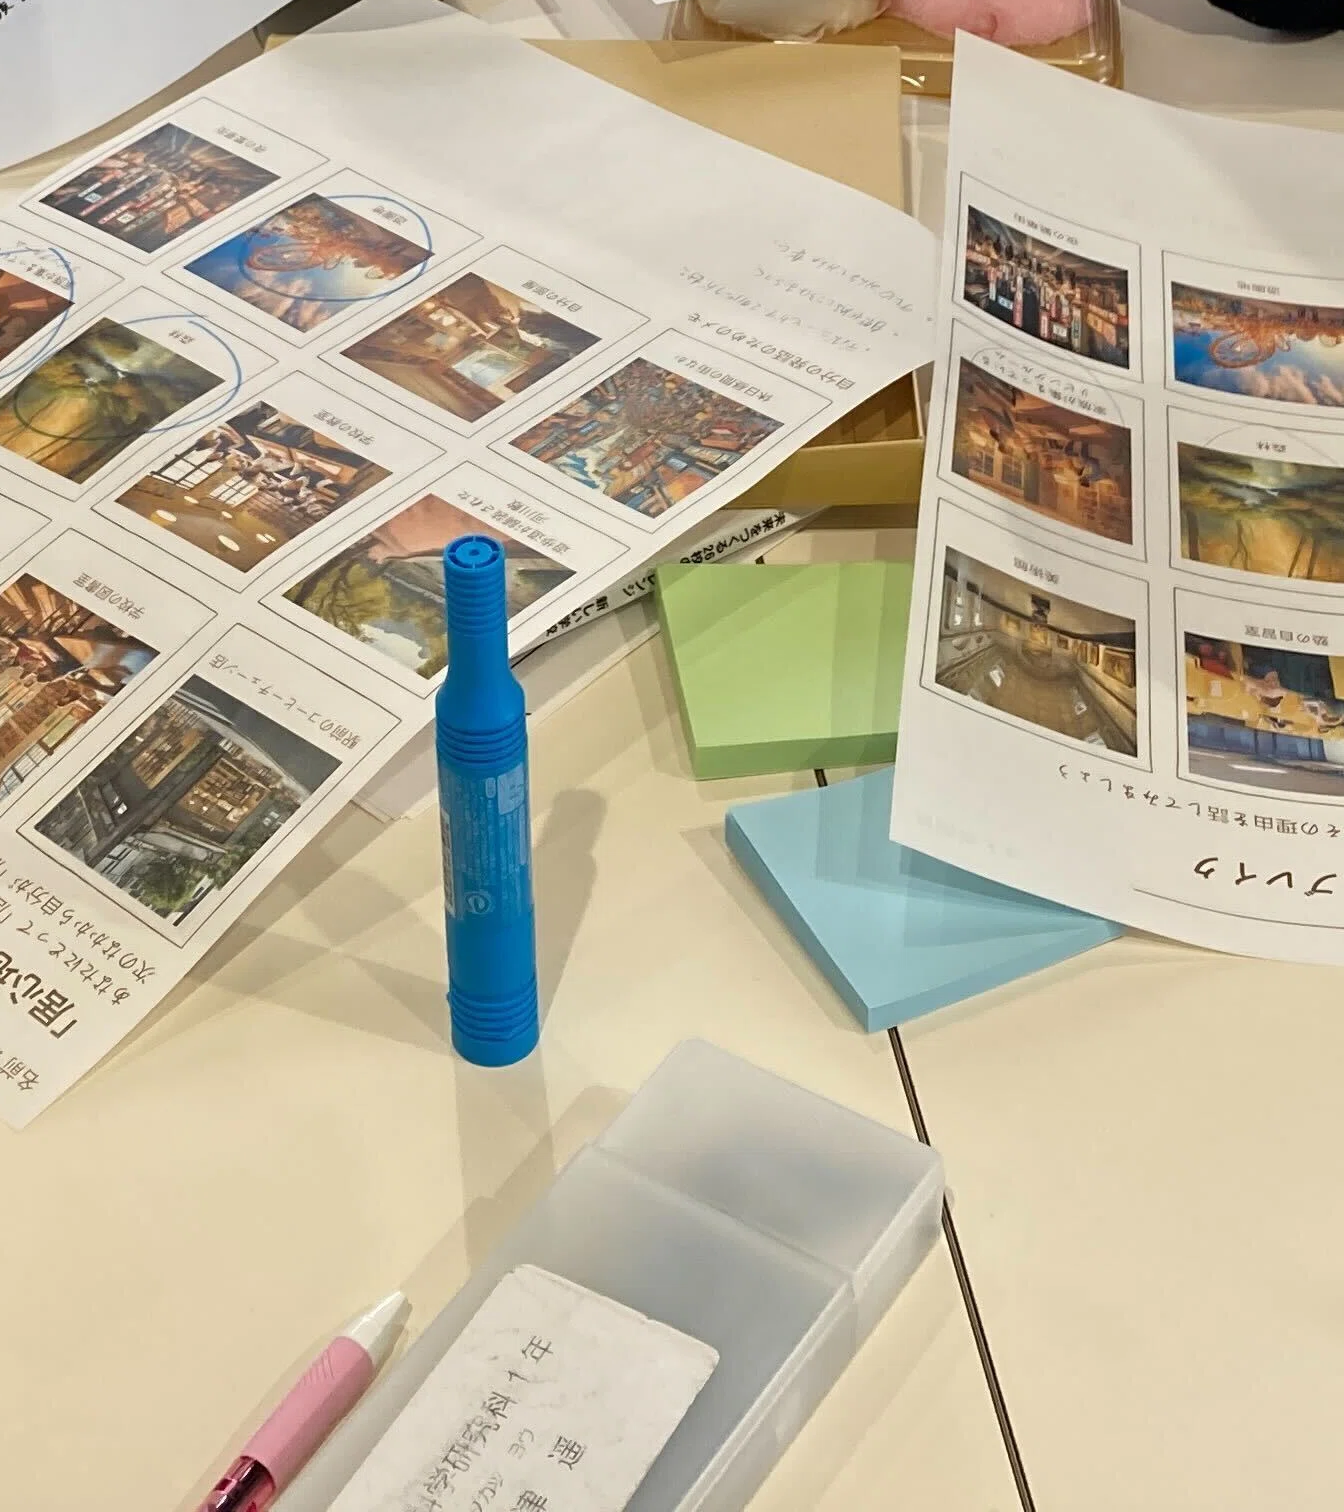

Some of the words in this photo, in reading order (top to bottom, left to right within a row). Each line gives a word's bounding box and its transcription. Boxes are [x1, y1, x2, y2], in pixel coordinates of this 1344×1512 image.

[520, 277, 584, 314] 自分の部屋
[687, 310, 856, 392] 自分の発話のためのメモ
[313, 406, 376, 447] 学校の教室
[1256, 439, 1288, 454] 森林
[73, 571, 146, 622] 学校の図書室
[1243, 622, 1330, 647] 塾の自習室
[208, 653, 362, 750] 駅前のコーヒーチェーン店
